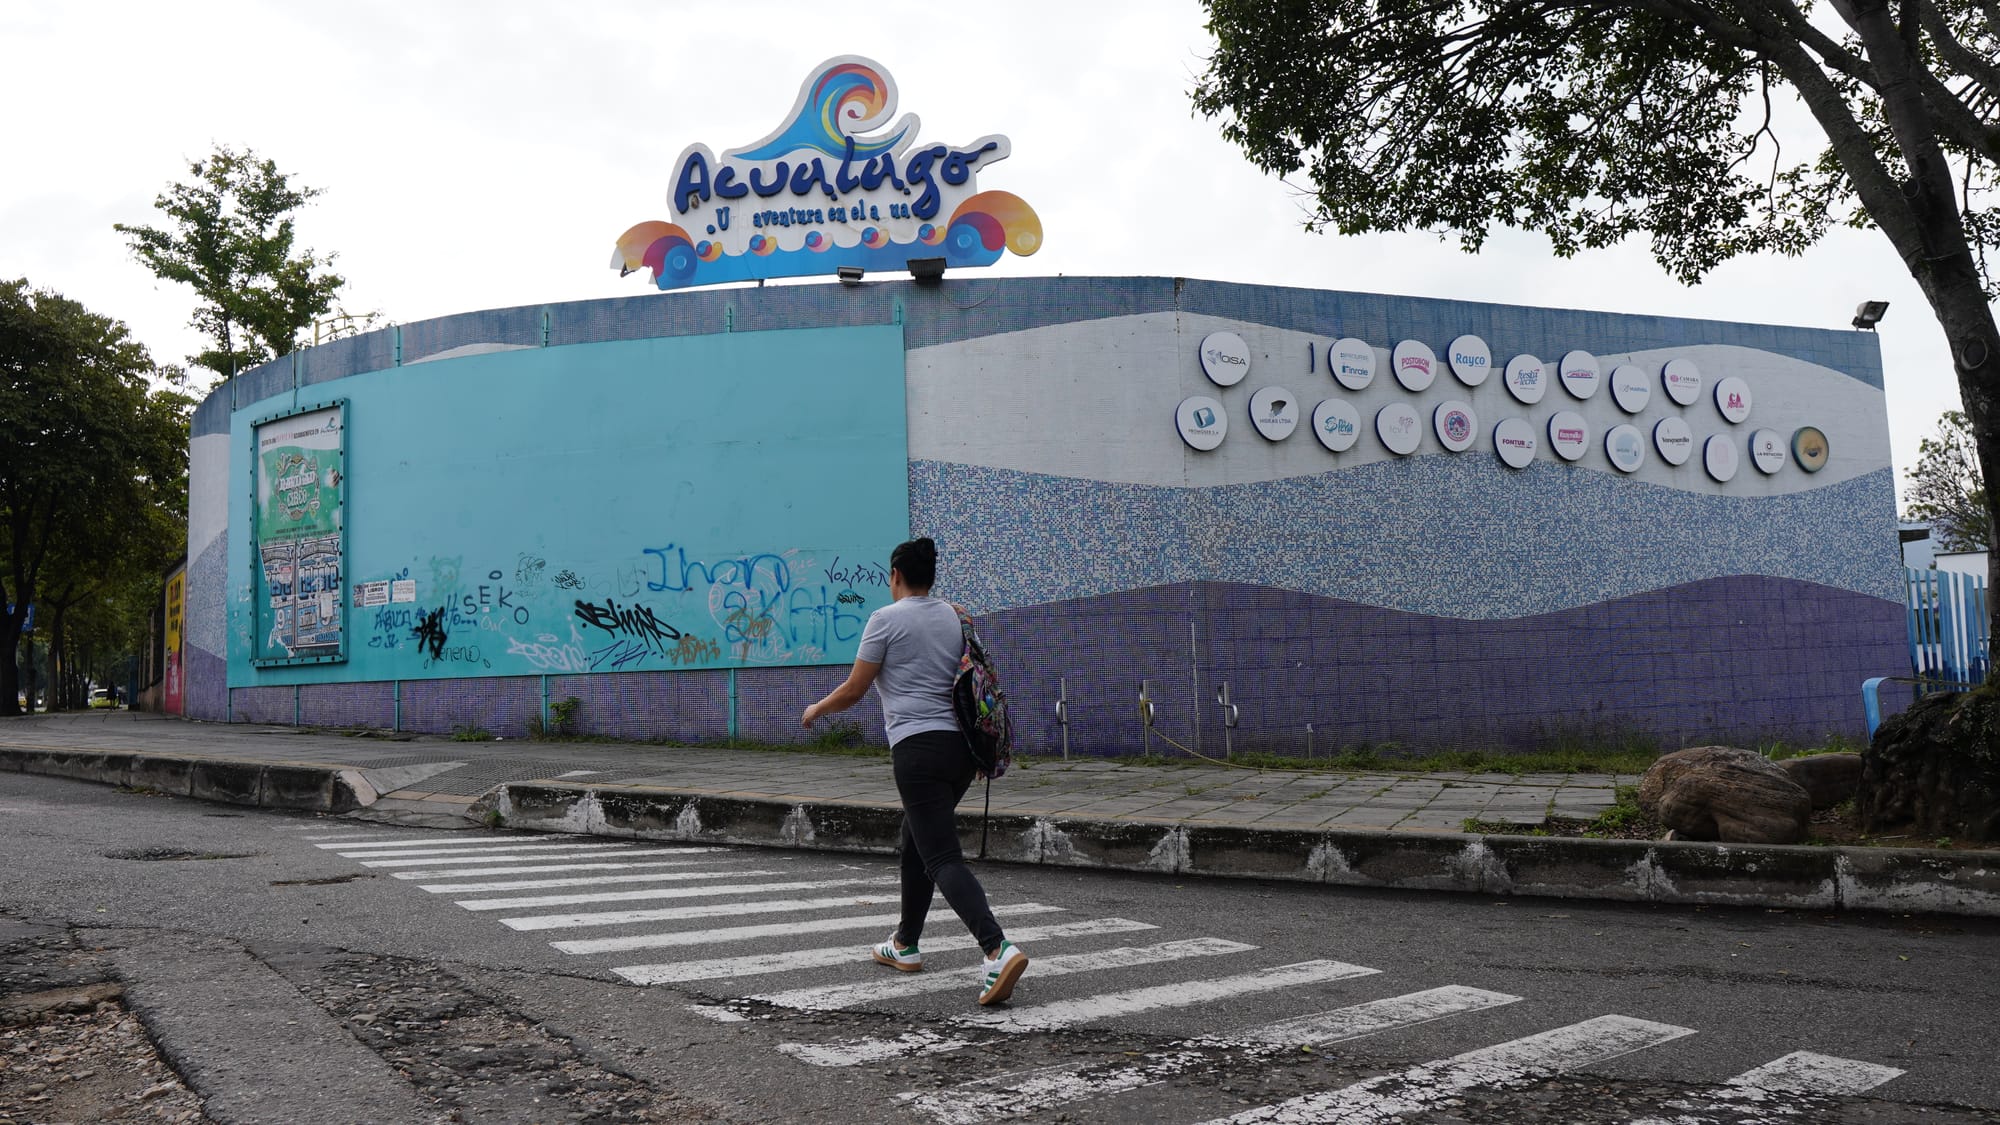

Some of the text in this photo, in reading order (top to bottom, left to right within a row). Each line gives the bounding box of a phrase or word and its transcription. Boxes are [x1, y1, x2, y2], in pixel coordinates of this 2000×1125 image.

[674, 136, 998, 220] Acualago
[753, 206, 825, 228] aventura
[828, 206, 847, 223] en
[851, 199, 866, 221] el
[1456, 353, 1486, 367] Rayco
